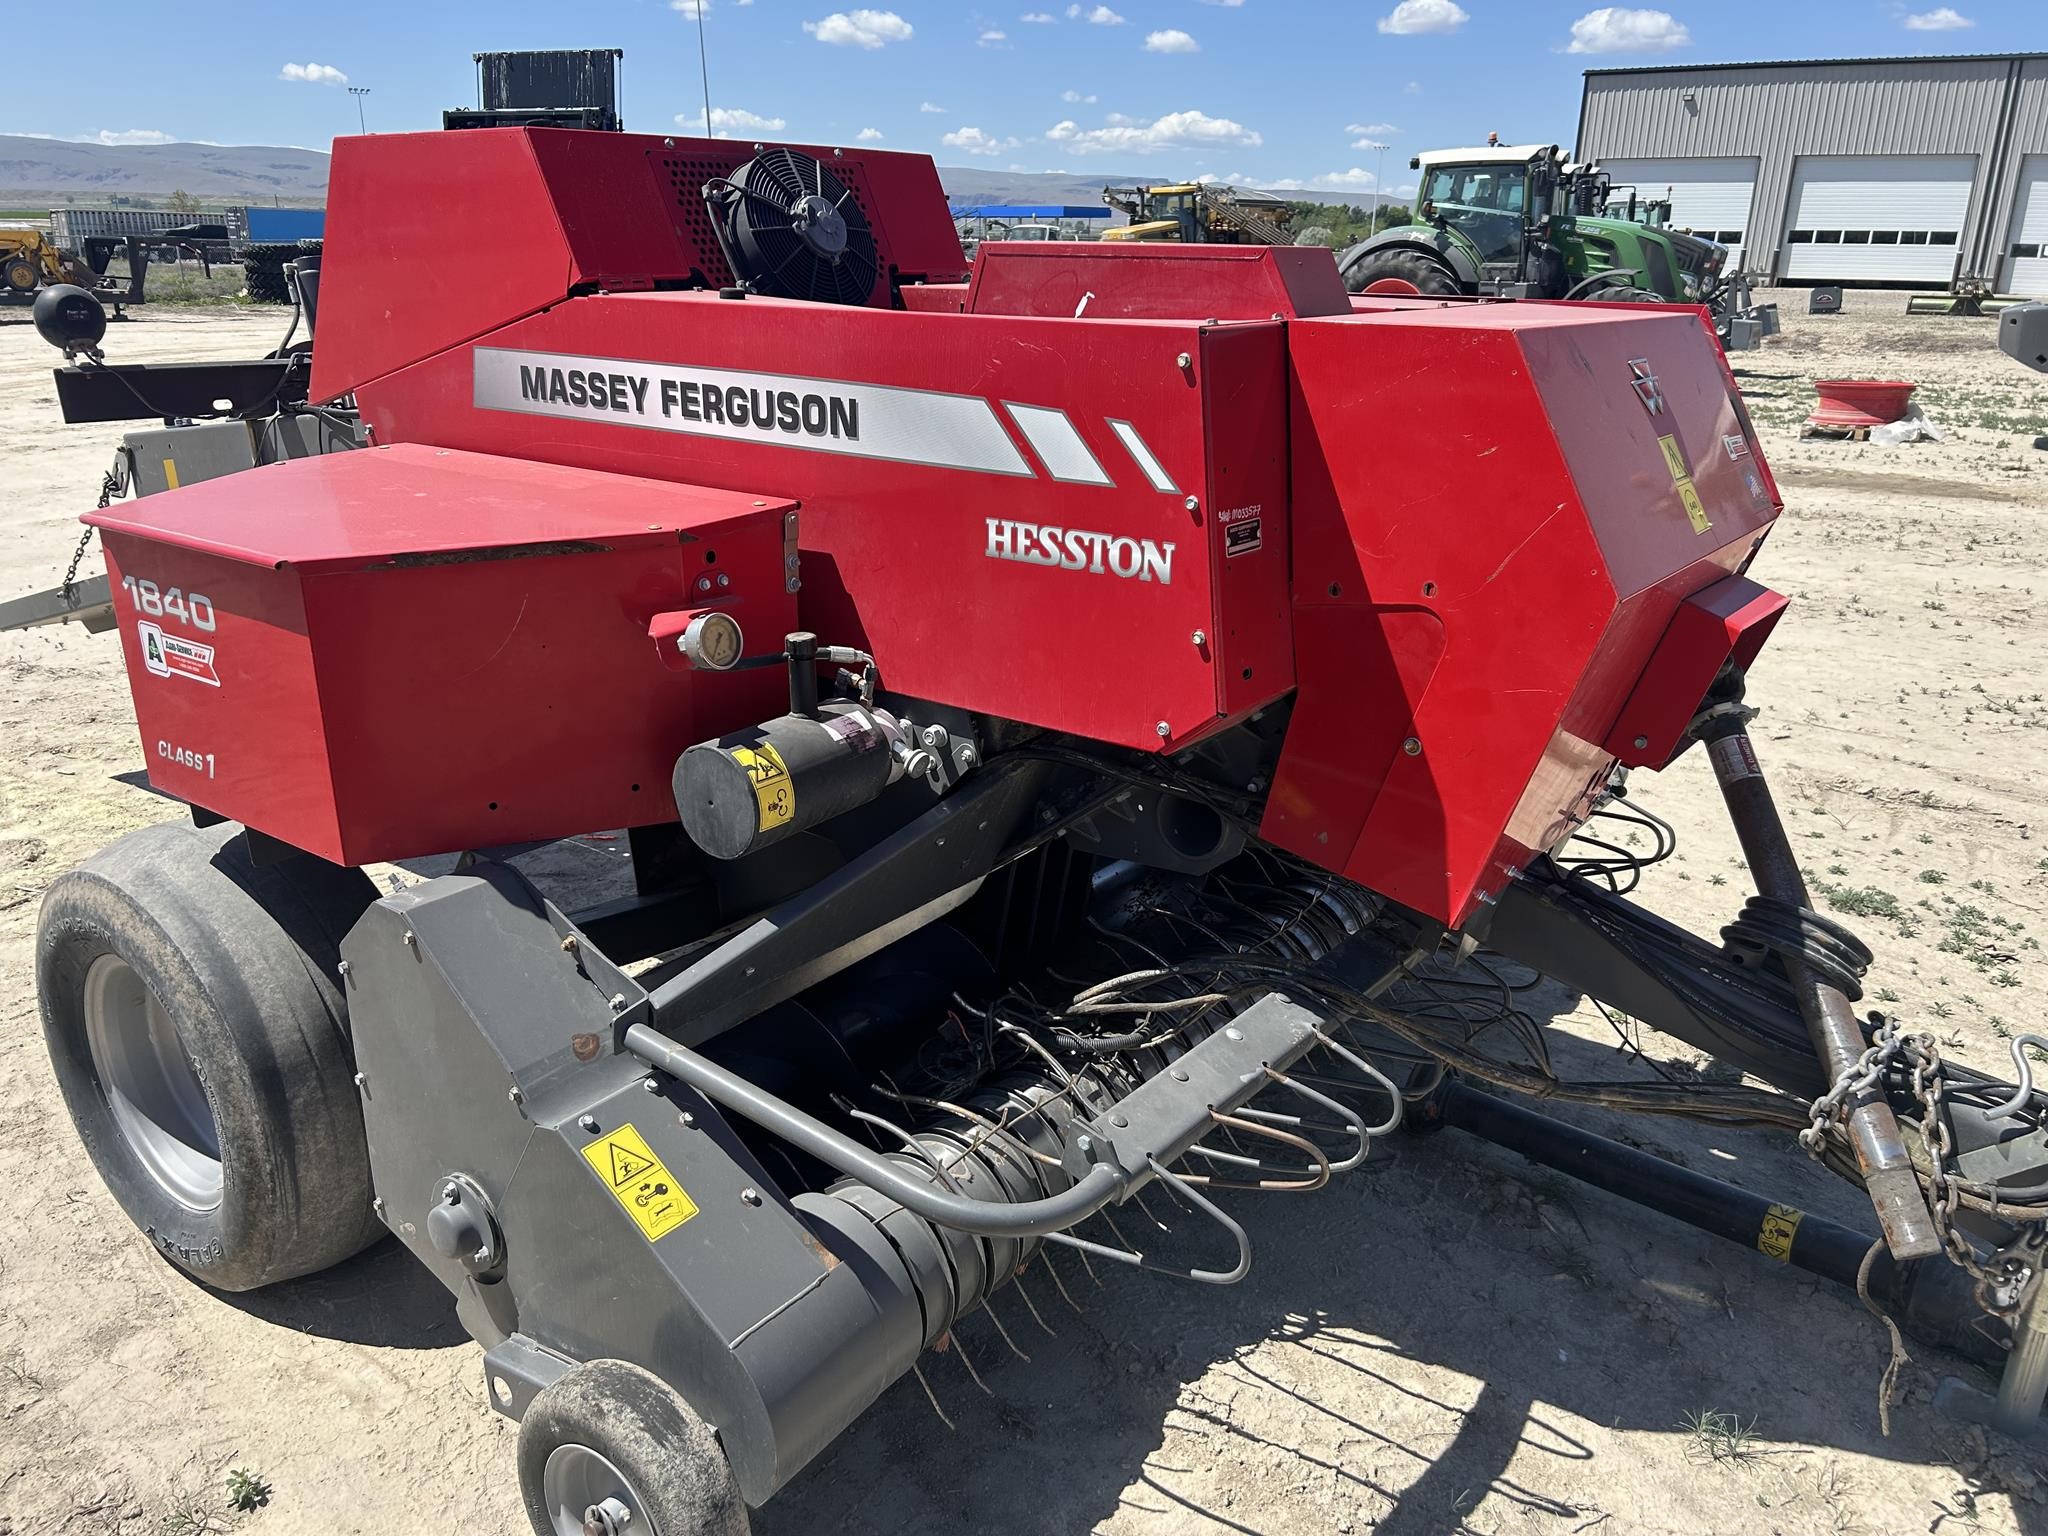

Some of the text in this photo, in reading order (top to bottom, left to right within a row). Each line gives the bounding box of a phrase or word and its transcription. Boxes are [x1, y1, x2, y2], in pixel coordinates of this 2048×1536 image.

[519, 365, 860, 442] MASSEY FERGUSON
[985, 517, 1176, 584] HESSTON
[122, 575, 216, 631] 1840
[158, 740, 215, 779] CLASS 1
[1740, 738, 1755, 763] DANGER
[145, 1224, 224, 1265] GALAXY
